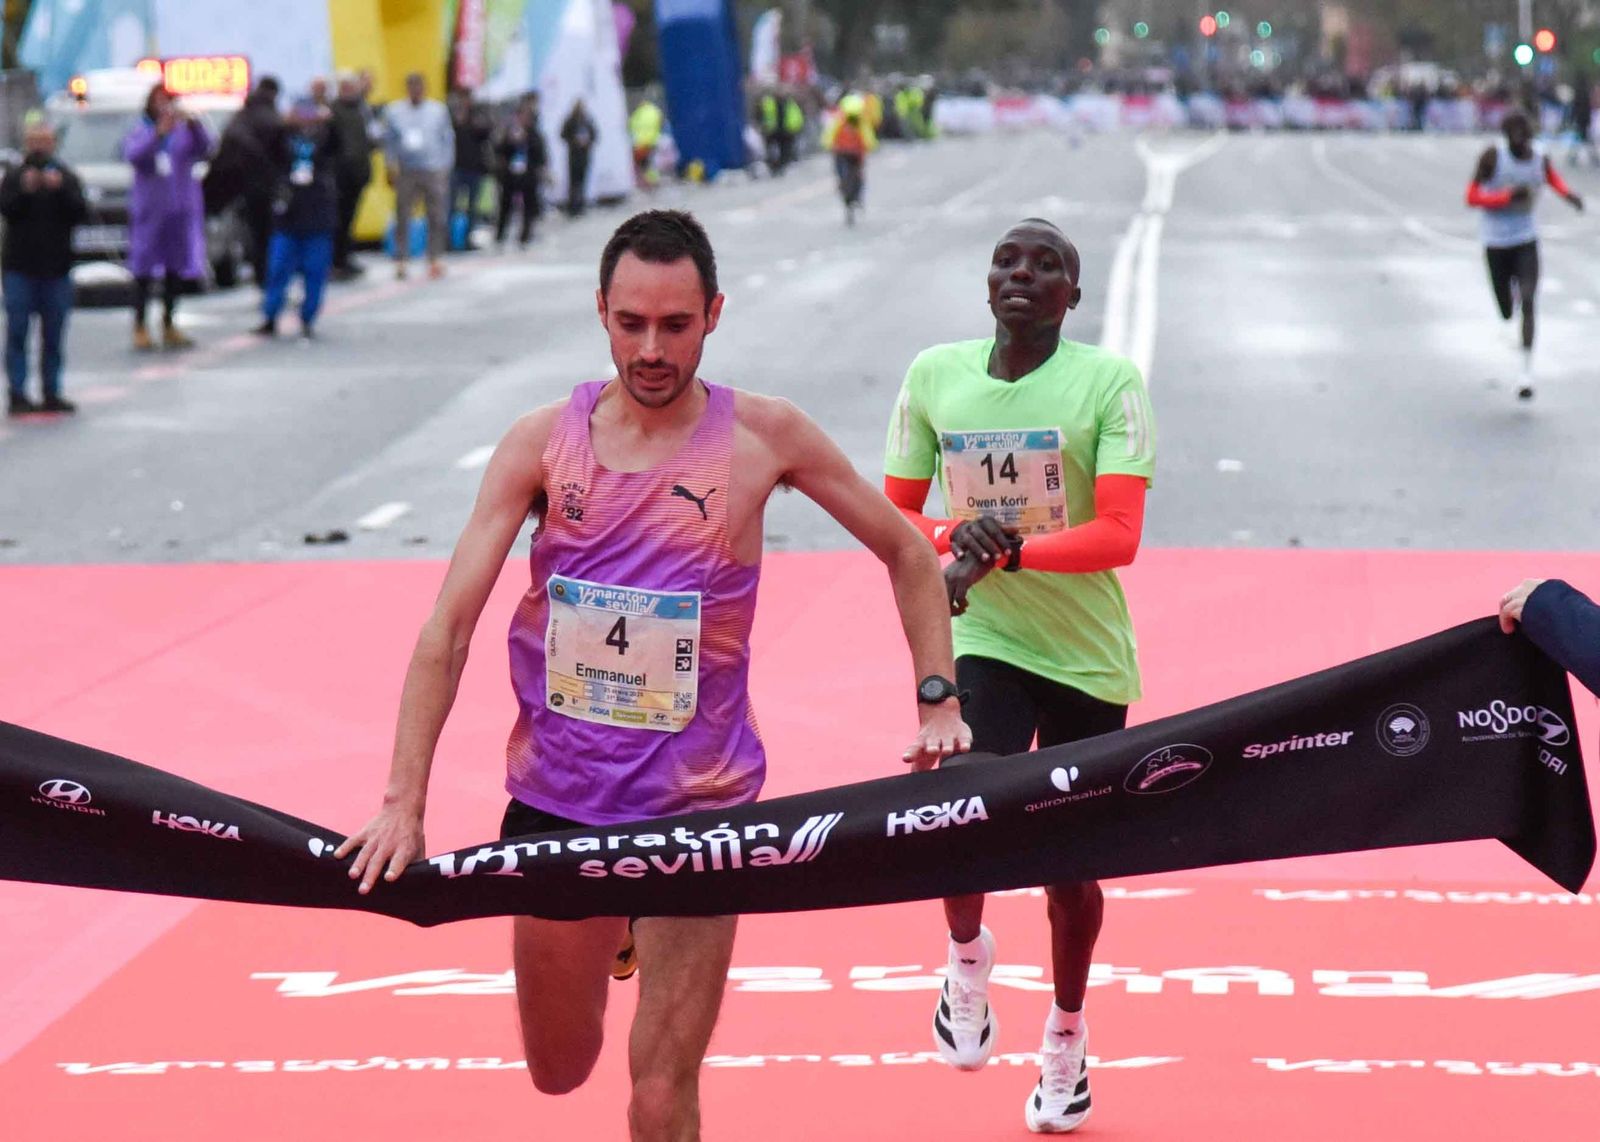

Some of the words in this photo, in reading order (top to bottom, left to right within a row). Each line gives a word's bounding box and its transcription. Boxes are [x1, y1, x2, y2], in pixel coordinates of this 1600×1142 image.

[980, 452, 1019, 485] 14
[967, 495, 997, 508] Owen
[1000, 495, 1029, 507] Korir
[594, 587, 648, 604] maratón
[605, 598, 648, 613] sevilla
[605, 615, 630, 656] 4
[576, 662, 647, 686] Emmanuel
[1241, 728, 1353, 760] Sprinter
[30, 795, 106, 817] HYUNDAI
[886, 795, 989, 837] HOKA
[152, 810, 244, 842] HOKA
[512, 820, 780, 858] maratón
[579, 832, 786, 879] sevilla
